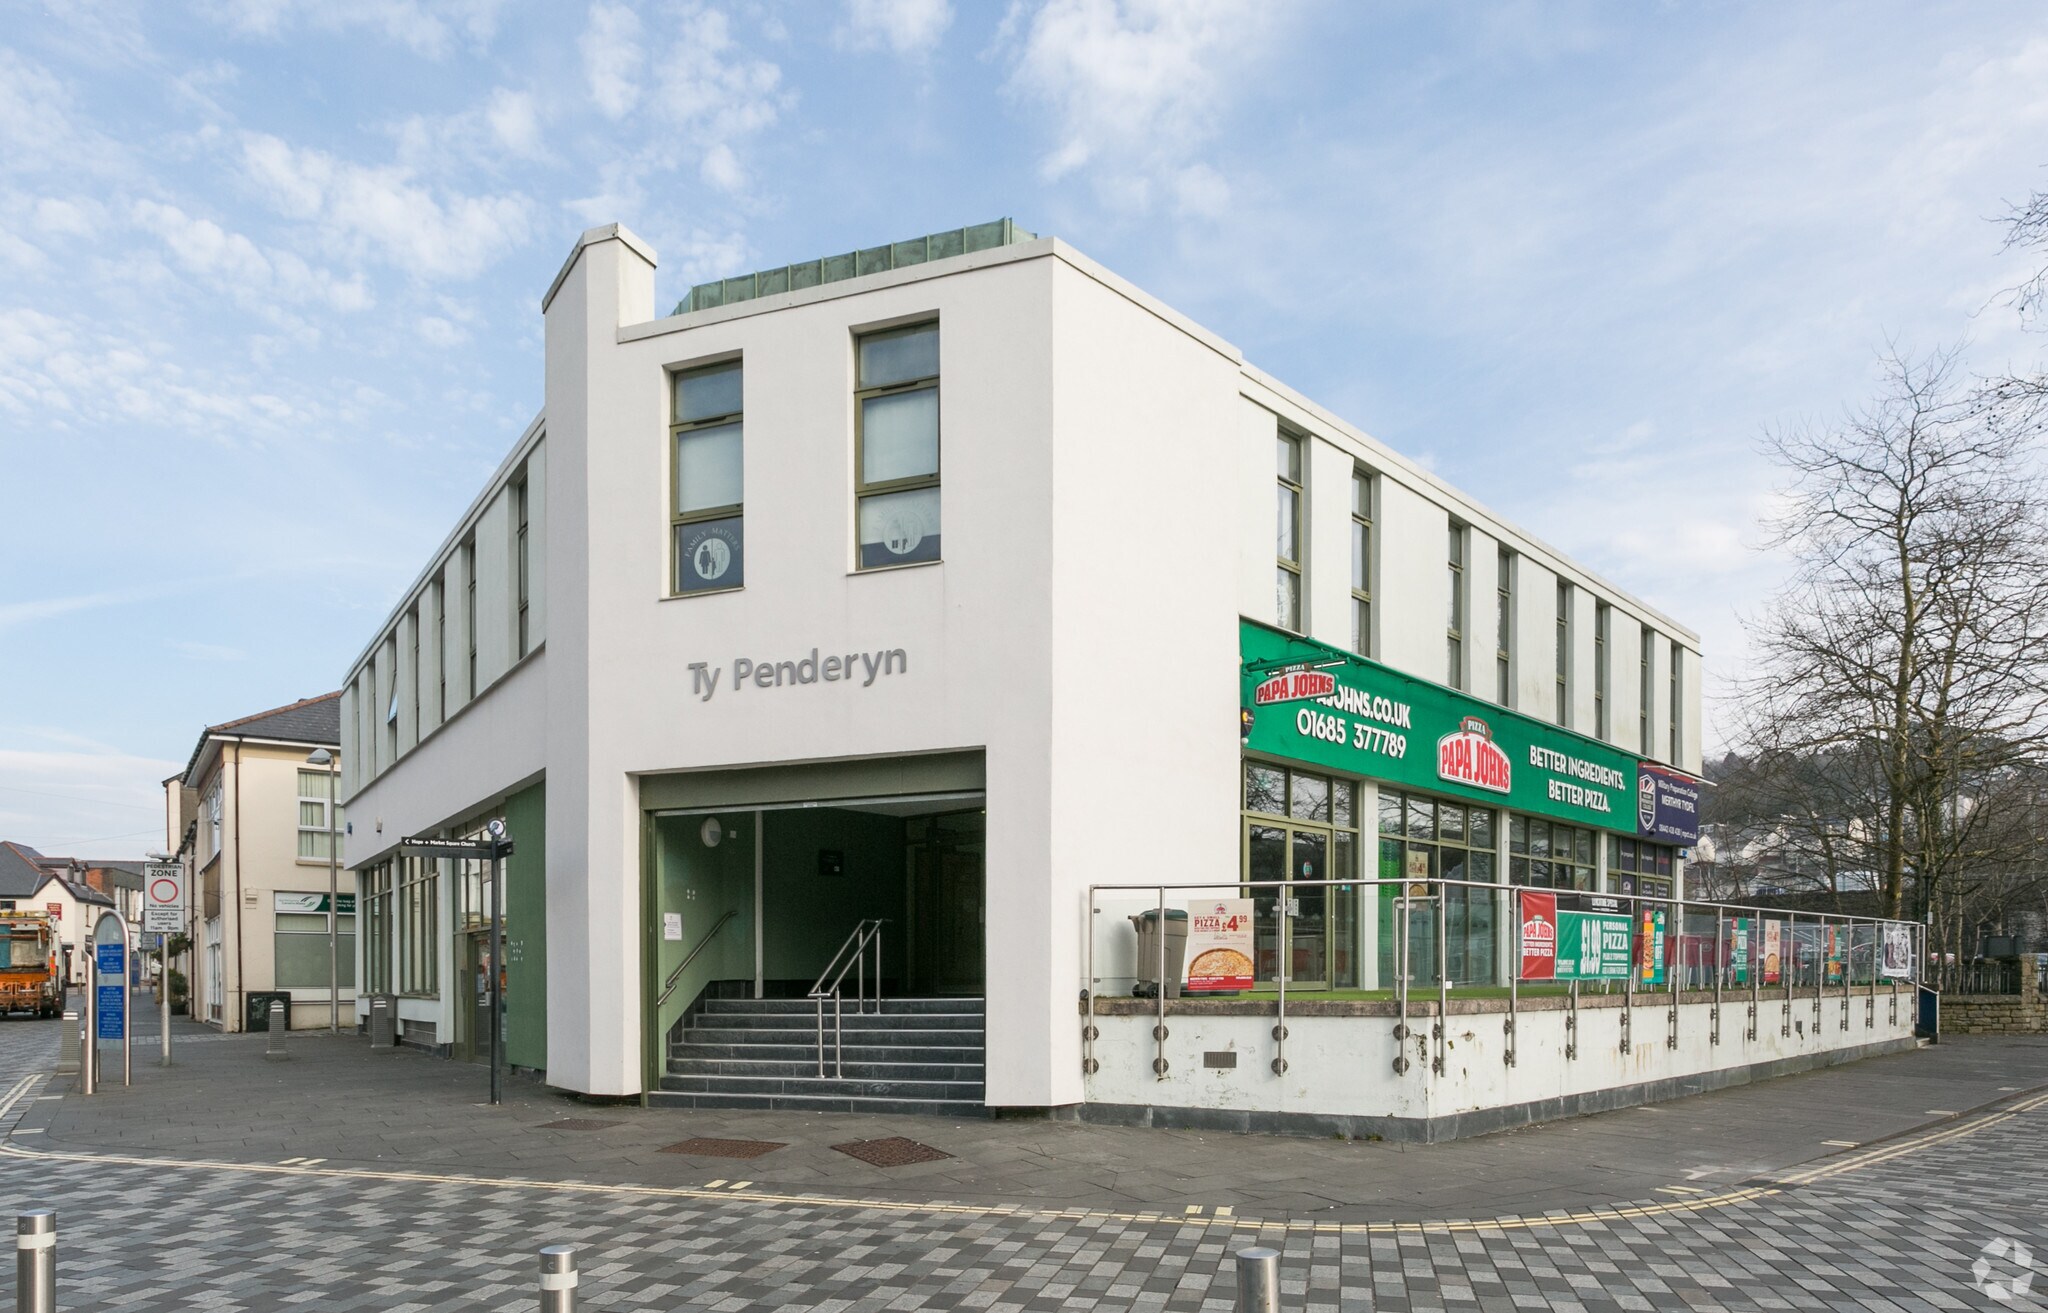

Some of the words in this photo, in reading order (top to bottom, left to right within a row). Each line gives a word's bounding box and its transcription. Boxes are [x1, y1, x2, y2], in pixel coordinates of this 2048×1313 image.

[684, 530, 706, 557] FAMILY
[712, 527, 740, 551] MATTERS
[688, 662, 721, 701] Ty
[733, 648, 907, 690] Penderyn
[1285, 664, 1305, 673] PIZZA
[1257, 676, 1289, 702] PAPA
[1291, 673, 1333, 697] JOHNS
[1296, 708, 1347, 745] 01685
[1353, 722, 1407, 759] 377789
[1467, 720, 1486, 734] PIZZA
[1441, 738, 1473, 779] PAPA
[1474, 739, 1510, 790] JOHNS
[1529, 745, 1566, 774] BETTER
[1567, 756, 1626, 791] INGREDIENTS.
[1548, 778, 1584, 806] BETTER
[1584, 788, 1611, 813] PIZZA.
[1194, 919, 1220, 927] PIZZA
[1524, 922, 1536, 937] PAPA
[1537, 923, 1553, 939] JOHNS
[1602, 921, 1628, 931] PERSONAL
[1523, 948, 1540, 956] BETTER
[1602, 932, 1628, 950] PIZZA
